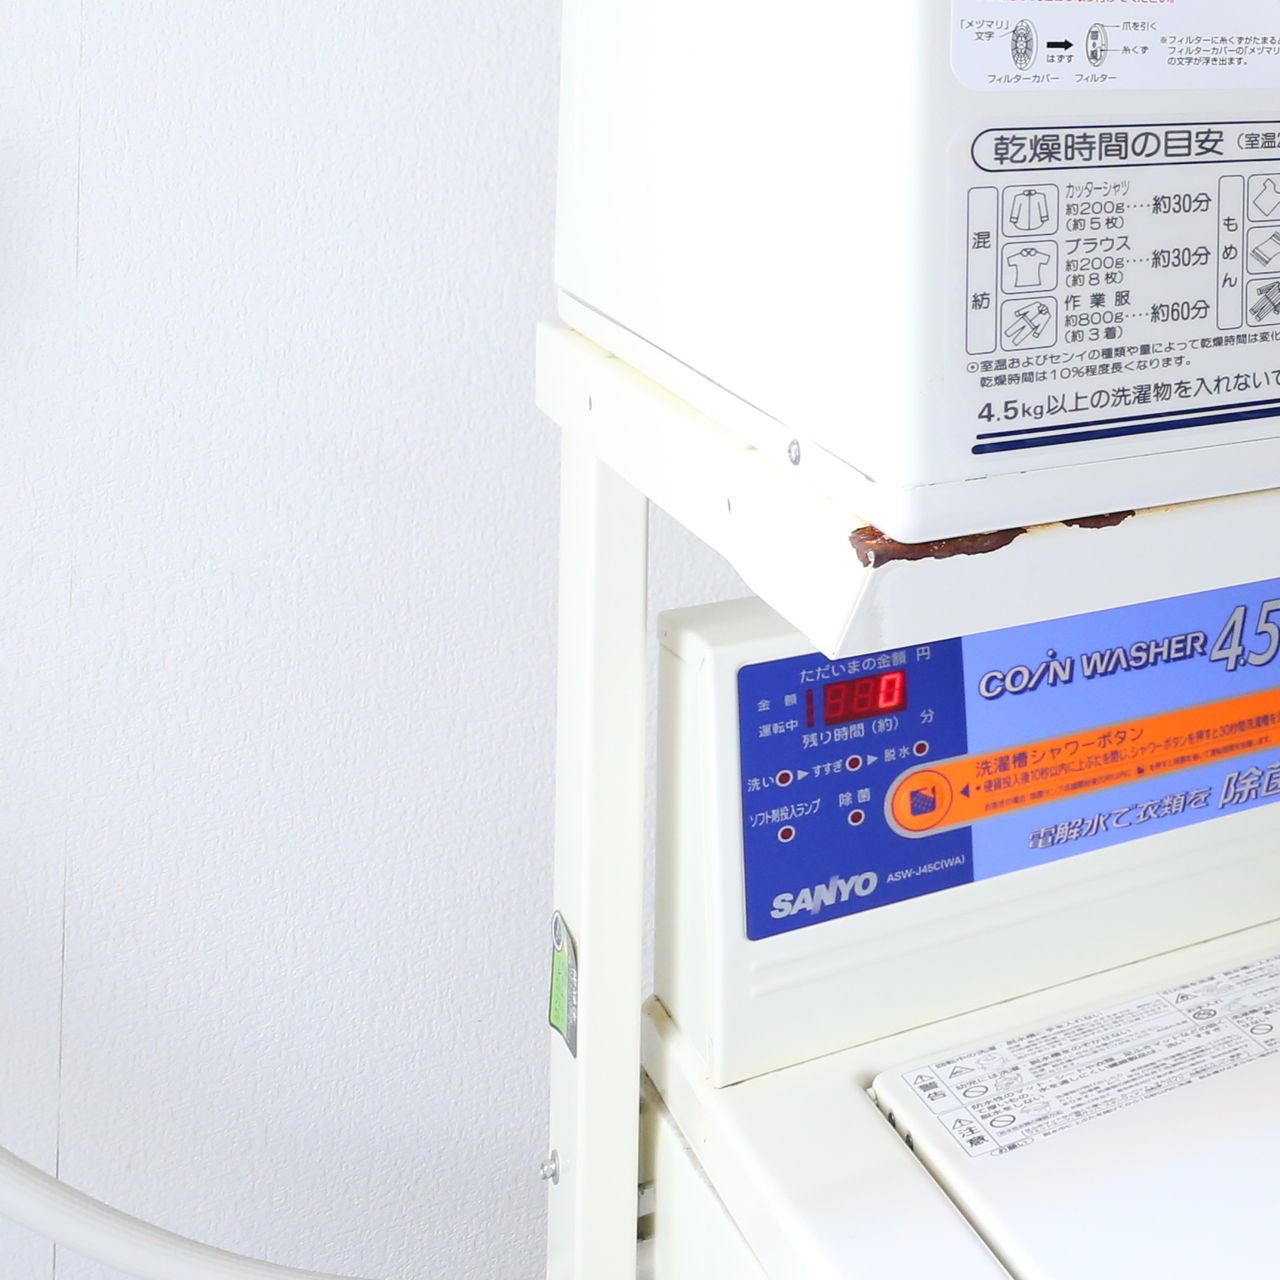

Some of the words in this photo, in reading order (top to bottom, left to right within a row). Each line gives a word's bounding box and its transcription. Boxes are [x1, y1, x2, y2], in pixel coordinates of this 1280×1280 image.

[975, 31, 995, 41] 文字
[1047, 54, 1074, 63] はずす
[1075, 73, 1117, 82] フィルター
[993, 129, 1224, 165] 乾燥時間の目安
[1066, 181, 1130, 199] カッターシャツ
[1066, 236, 1131, 255] ブラウス
[1222, 217, 1238, 288] もめん
[800, 649, 906, 684] ただいまの金額
[916, 647, 931, 661] 円
[1081, 631, 1208, 676] WASHER
[758, 720, 798, 738] 運転中
[920, 709, 935, 725] 分
[975, 727, 1144, 778] 洗濯槽シャワーボタン
[747, 776, 774, 792] 洗い
[813, 759, 843, 778] すすぎ
[884, 747, 910, 762] 脱水
[839, 788, 871, 808] 除菌
[750, 798, 821, 828] ソフト剤投入ランプ
[770, 870, 878, 921] SANYO
[886, 854, 965, 884] ASW-J45C(WA)
